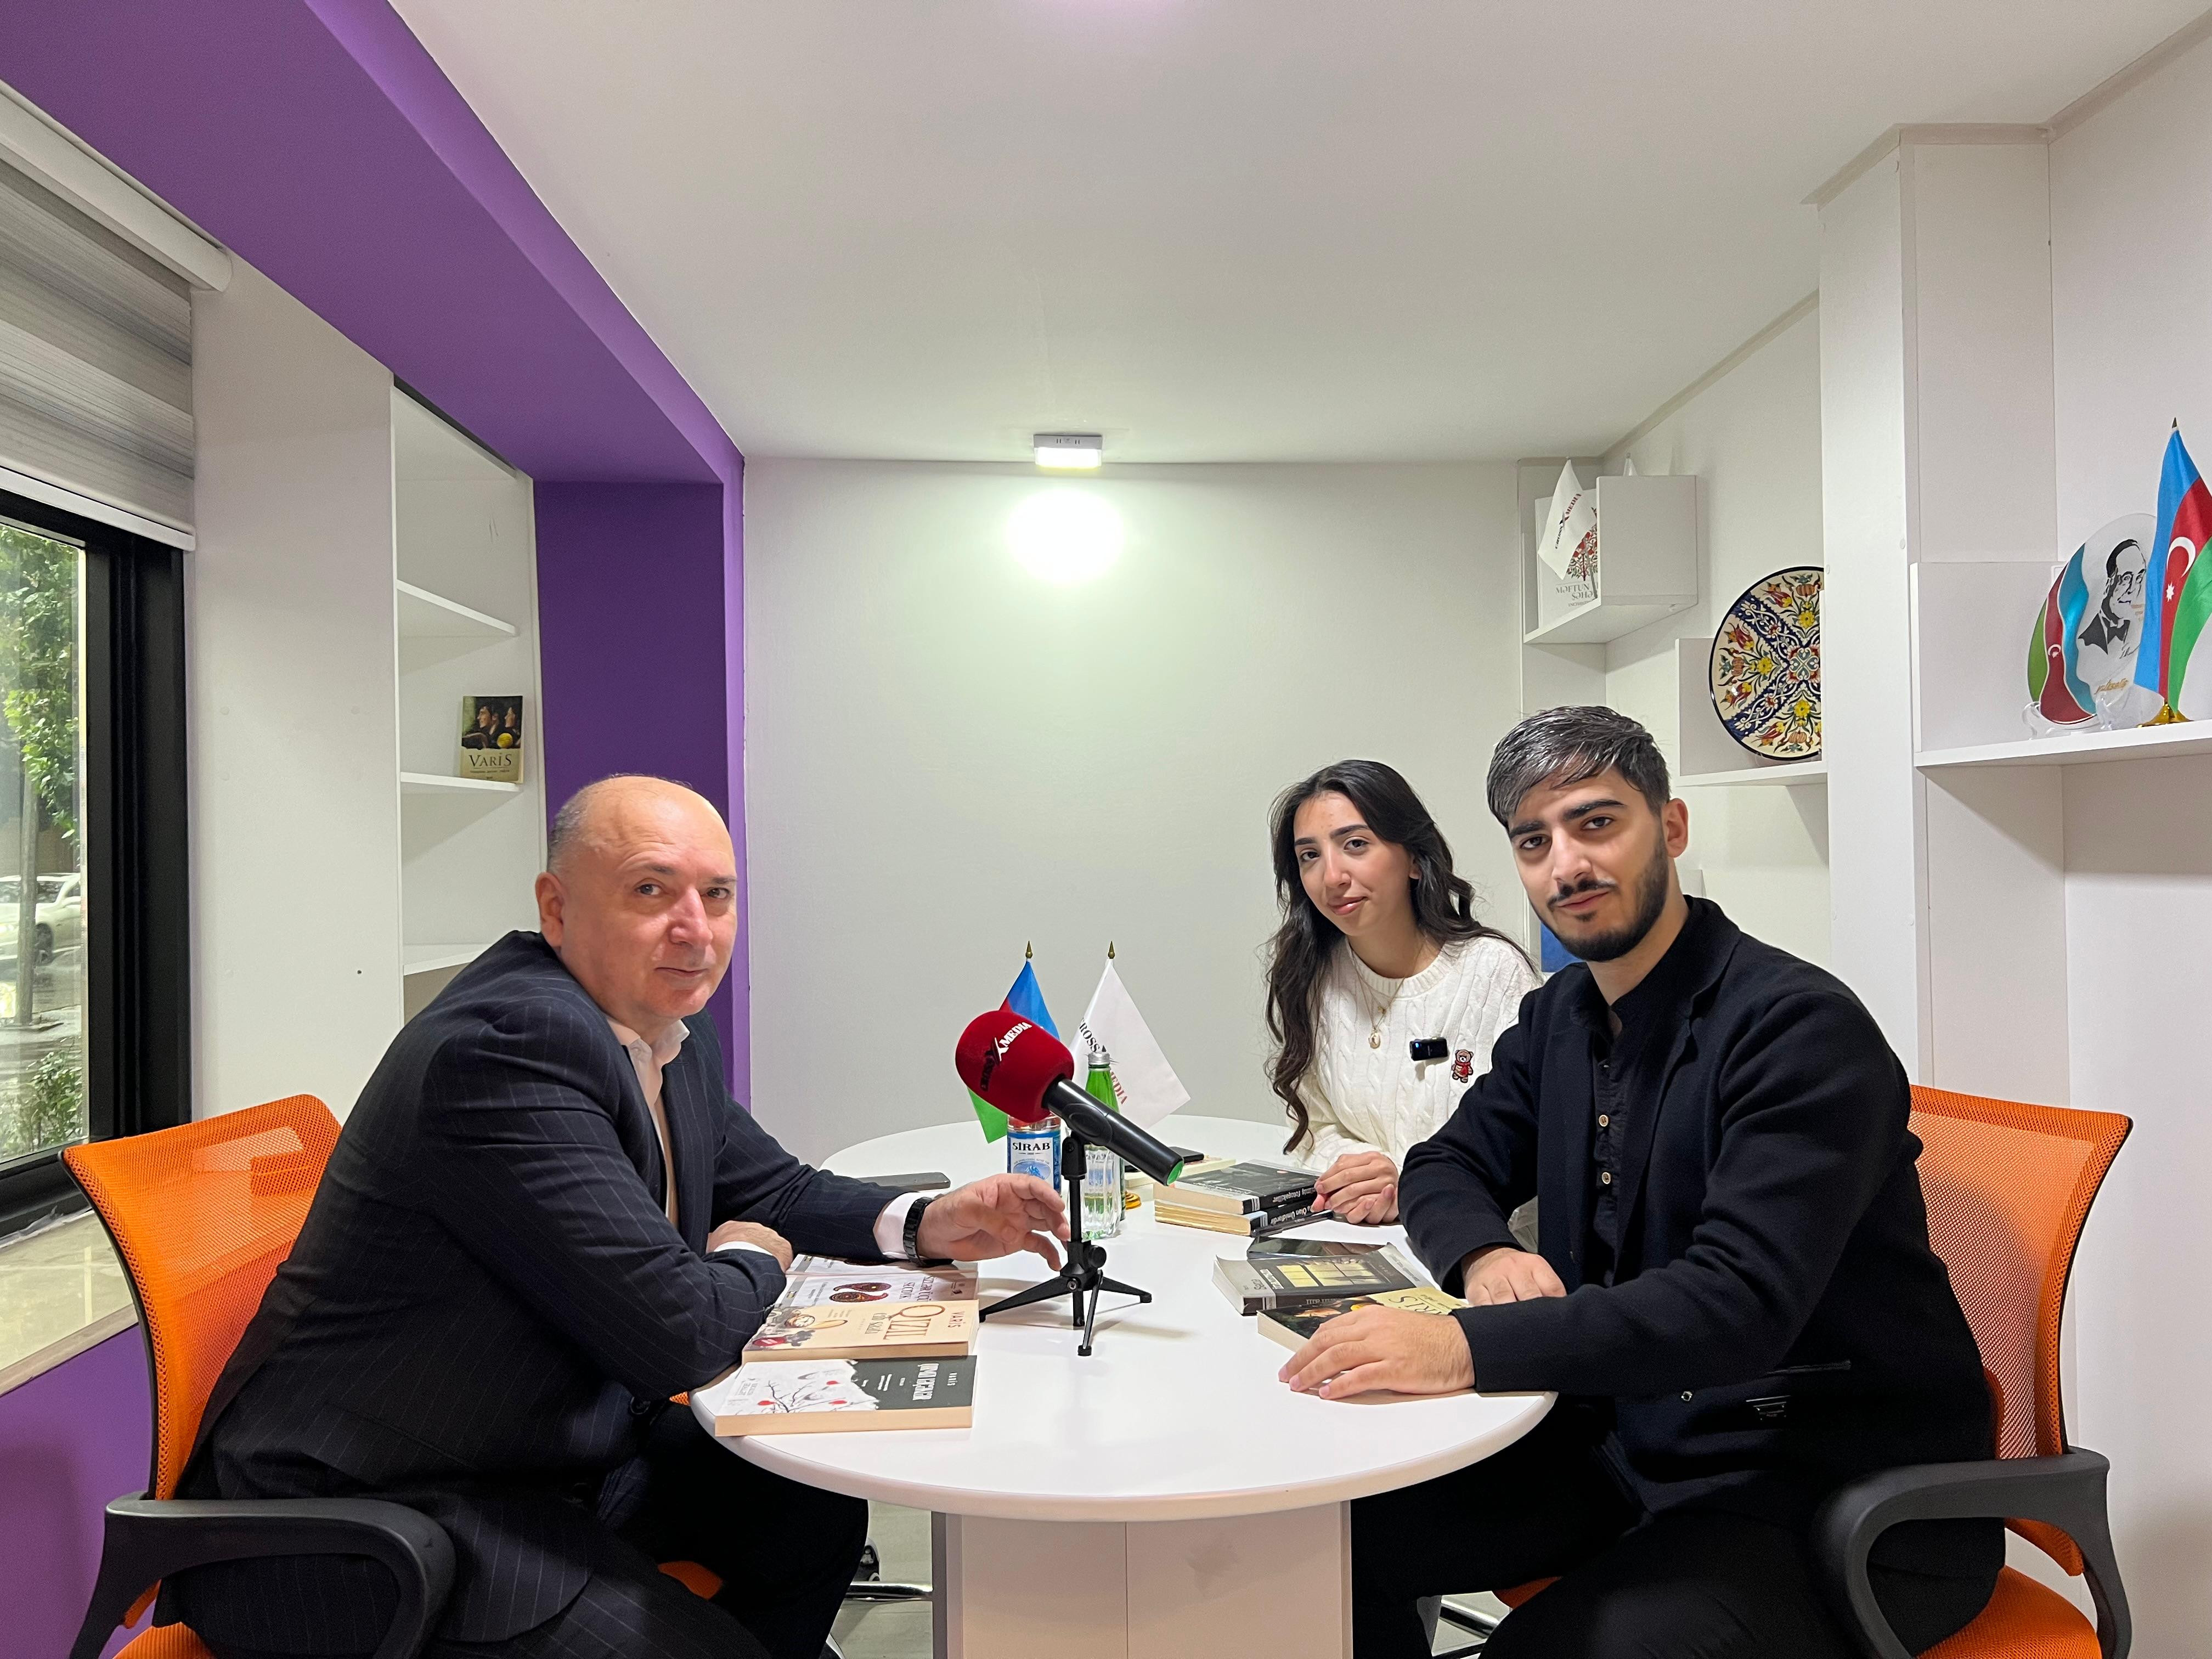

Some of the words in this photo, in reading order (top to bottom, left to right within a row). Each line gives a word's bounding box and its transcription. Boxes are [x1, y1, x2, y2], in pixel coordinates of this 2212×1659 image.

[469, 752, 512, 767] VARİS
[998, 1022, 1032, 1048] MEDIA
[883, 1305, 946, 1340] QIZIL
[947, 1311, 966, 1328] VARİS
